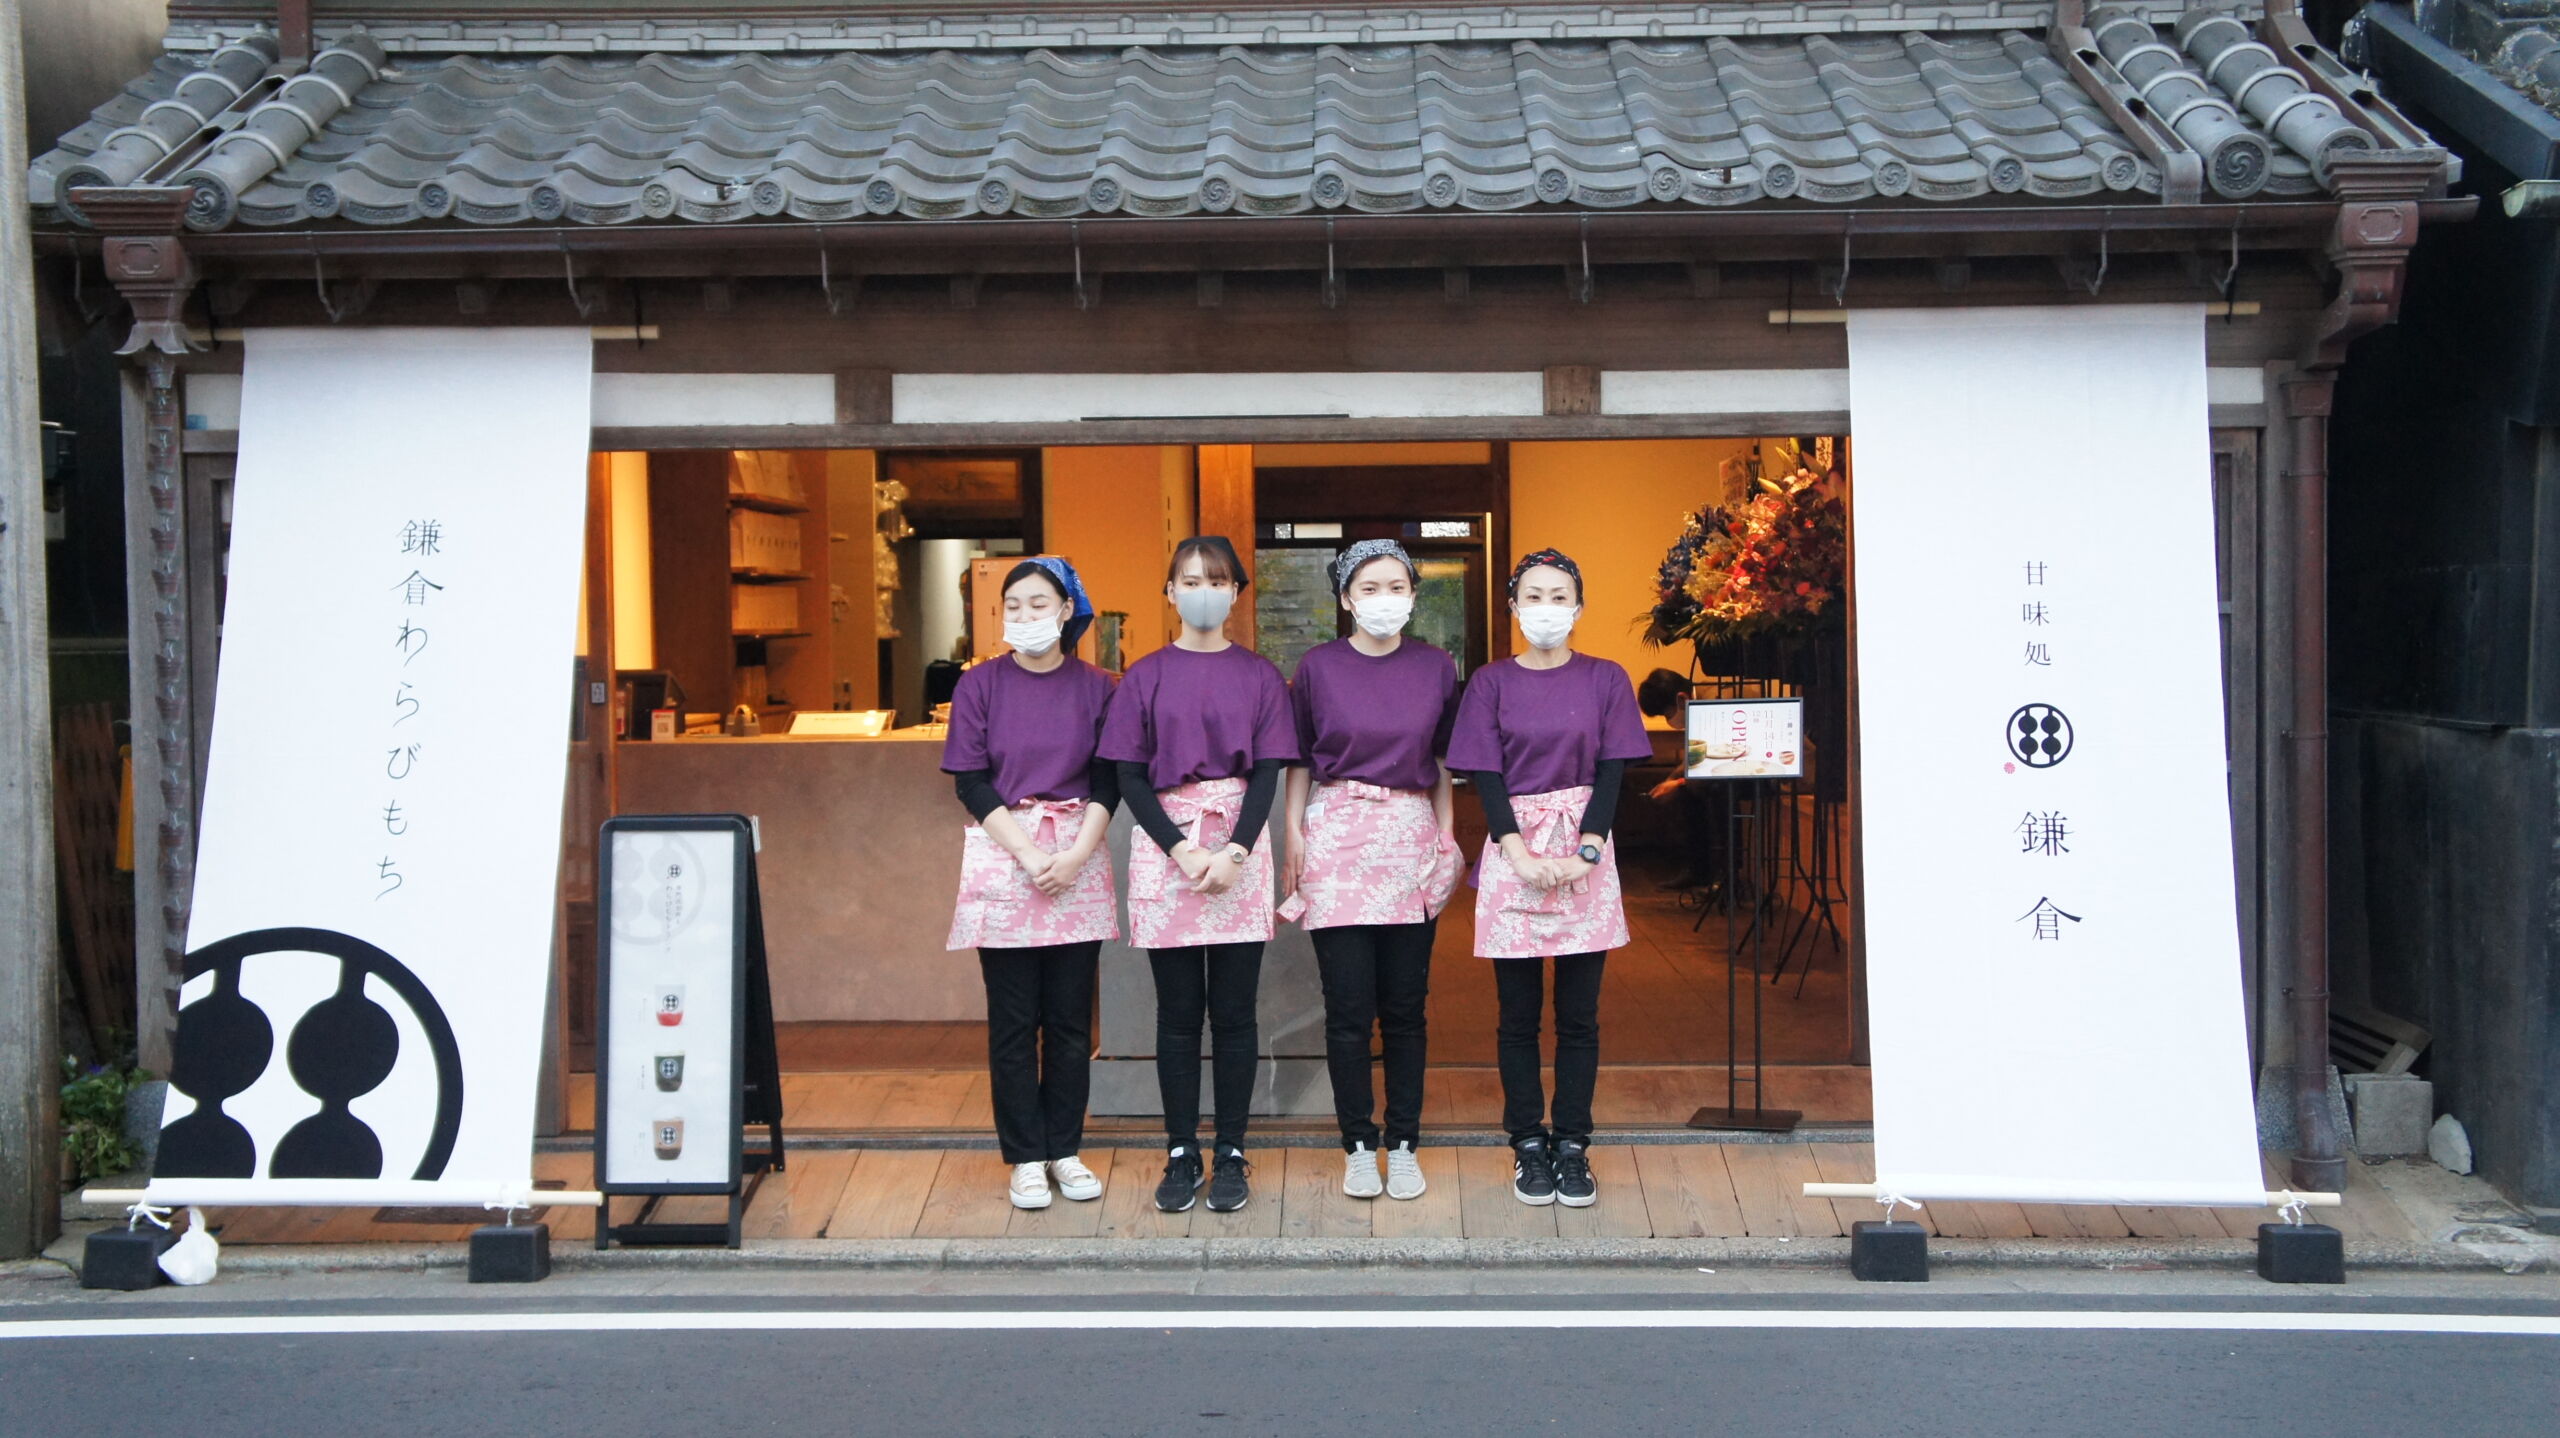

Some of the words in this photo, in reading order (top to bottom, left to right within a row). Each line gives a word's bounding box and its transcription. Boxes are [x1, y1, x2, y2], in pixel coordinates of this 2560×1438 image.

[2022, 560, 2052, 667] 甘味処
[375, 518, 446, 901] 鎌倉わらびもち
[2013, 810, 2084, 942] 鎌倉
